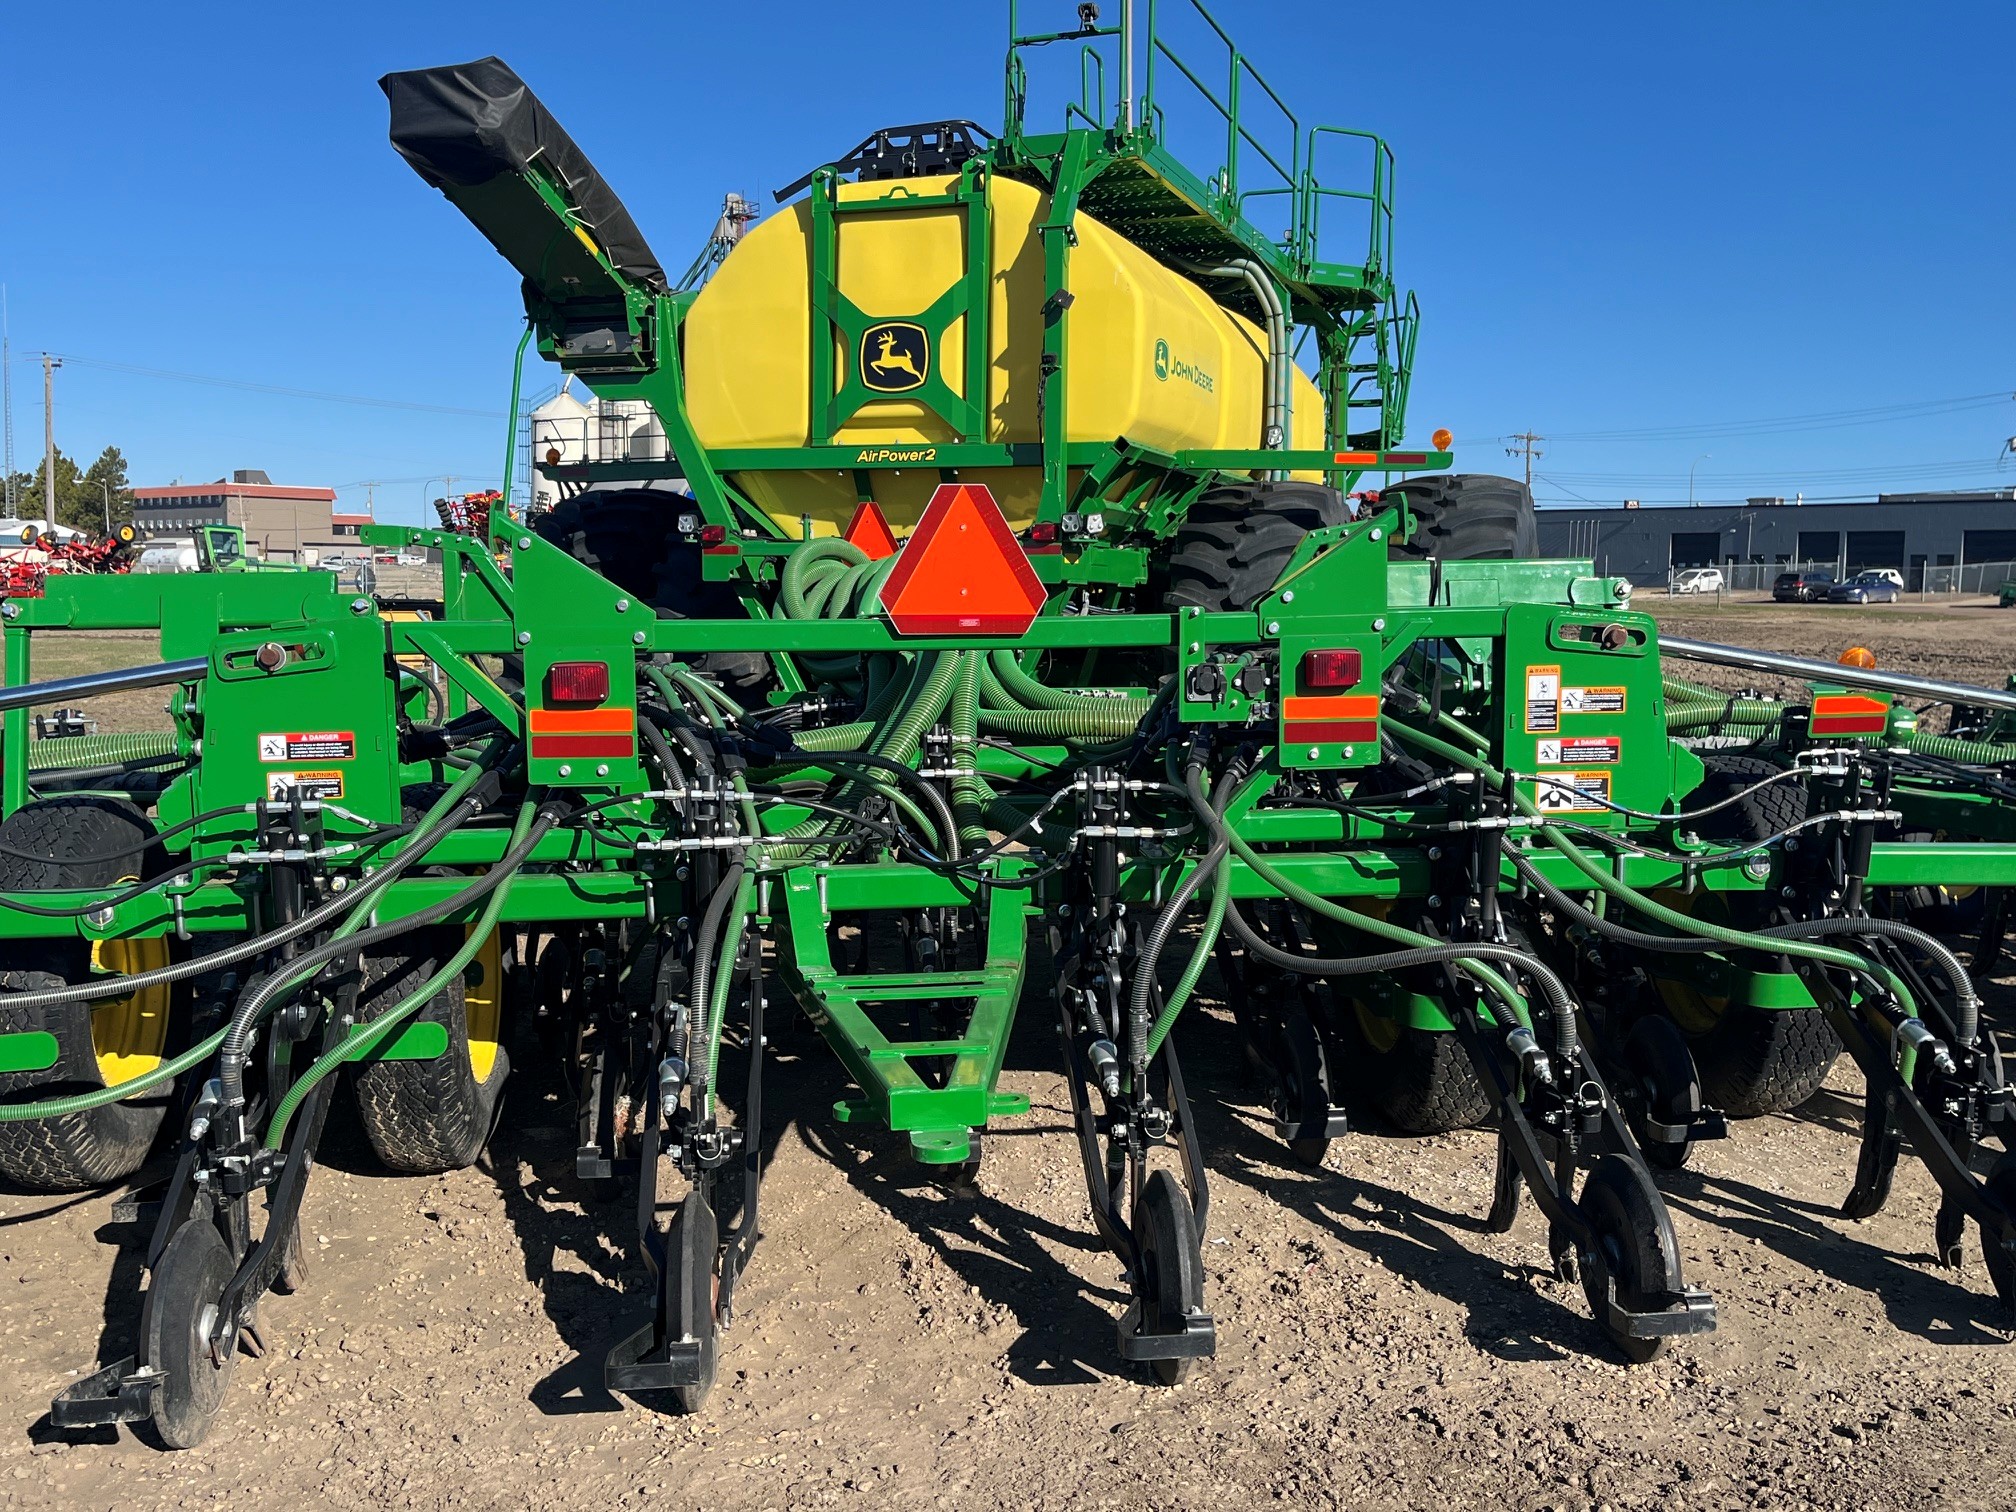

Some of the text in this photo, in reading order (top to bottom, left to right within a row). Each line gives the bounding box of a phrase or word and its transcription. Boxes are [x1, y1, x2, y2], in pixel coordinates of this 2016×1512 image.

[1170, 355, 1213, 393] JOHN DEERE
[856, 448, 936, 463] AirPower2
[308, 733, 339, 741] DANGER
[304, 771, 339, 779] WARNING
